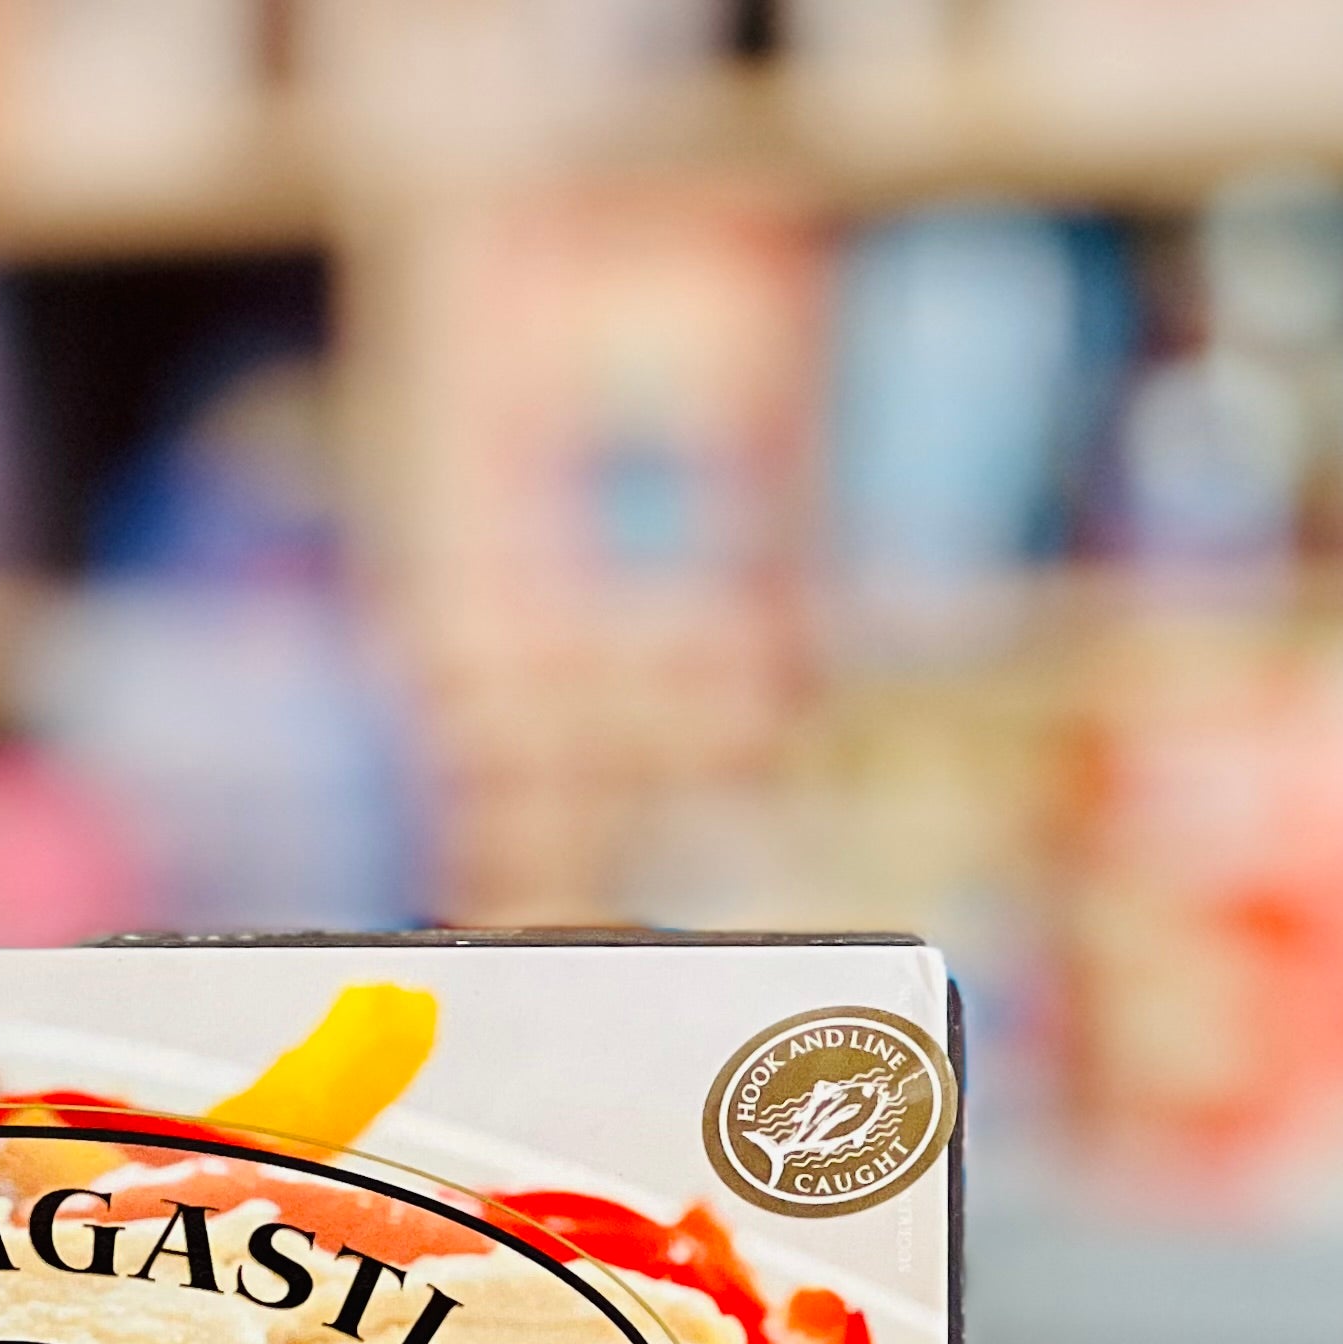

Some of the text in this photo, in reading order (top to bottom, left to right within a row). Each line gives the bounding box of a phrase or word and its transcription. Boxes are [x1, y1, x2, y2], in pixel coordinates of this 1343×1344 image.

[737, 1028, 907, 1122] HOOK AND LINE
[794, 1136, 908, 1194] CAUGHT
